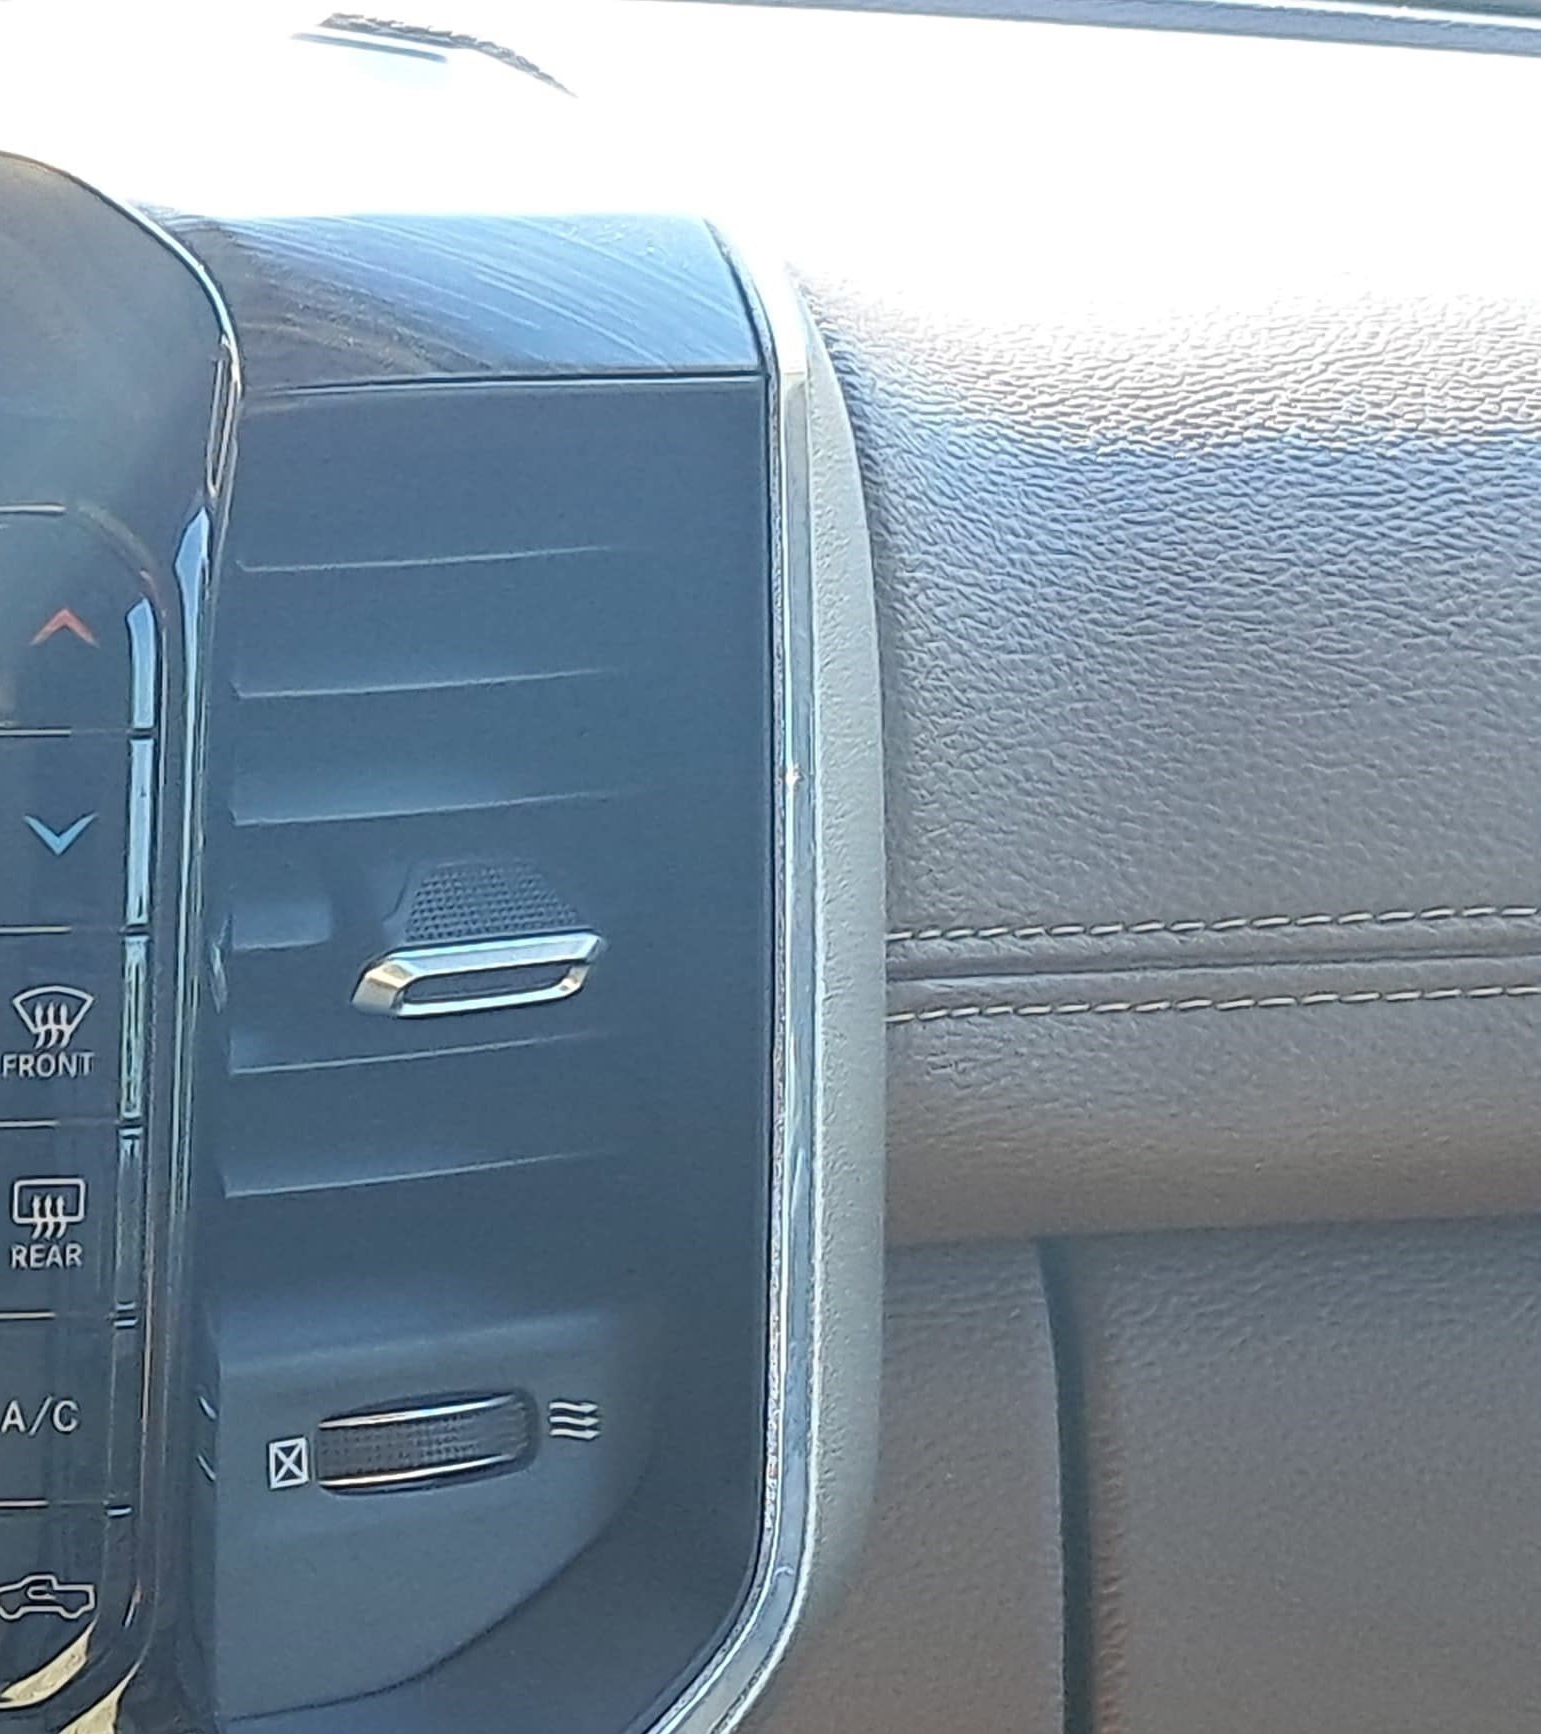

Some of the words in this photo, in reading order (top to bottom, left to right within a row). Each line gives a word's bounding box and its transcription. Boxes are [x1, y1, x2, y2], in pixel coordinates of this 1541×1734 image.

[2, 1053, 95, 1078] FRONT
[10, 1244, 84, 1268] REAR
[1, 1400, 80, 1434] A/C
